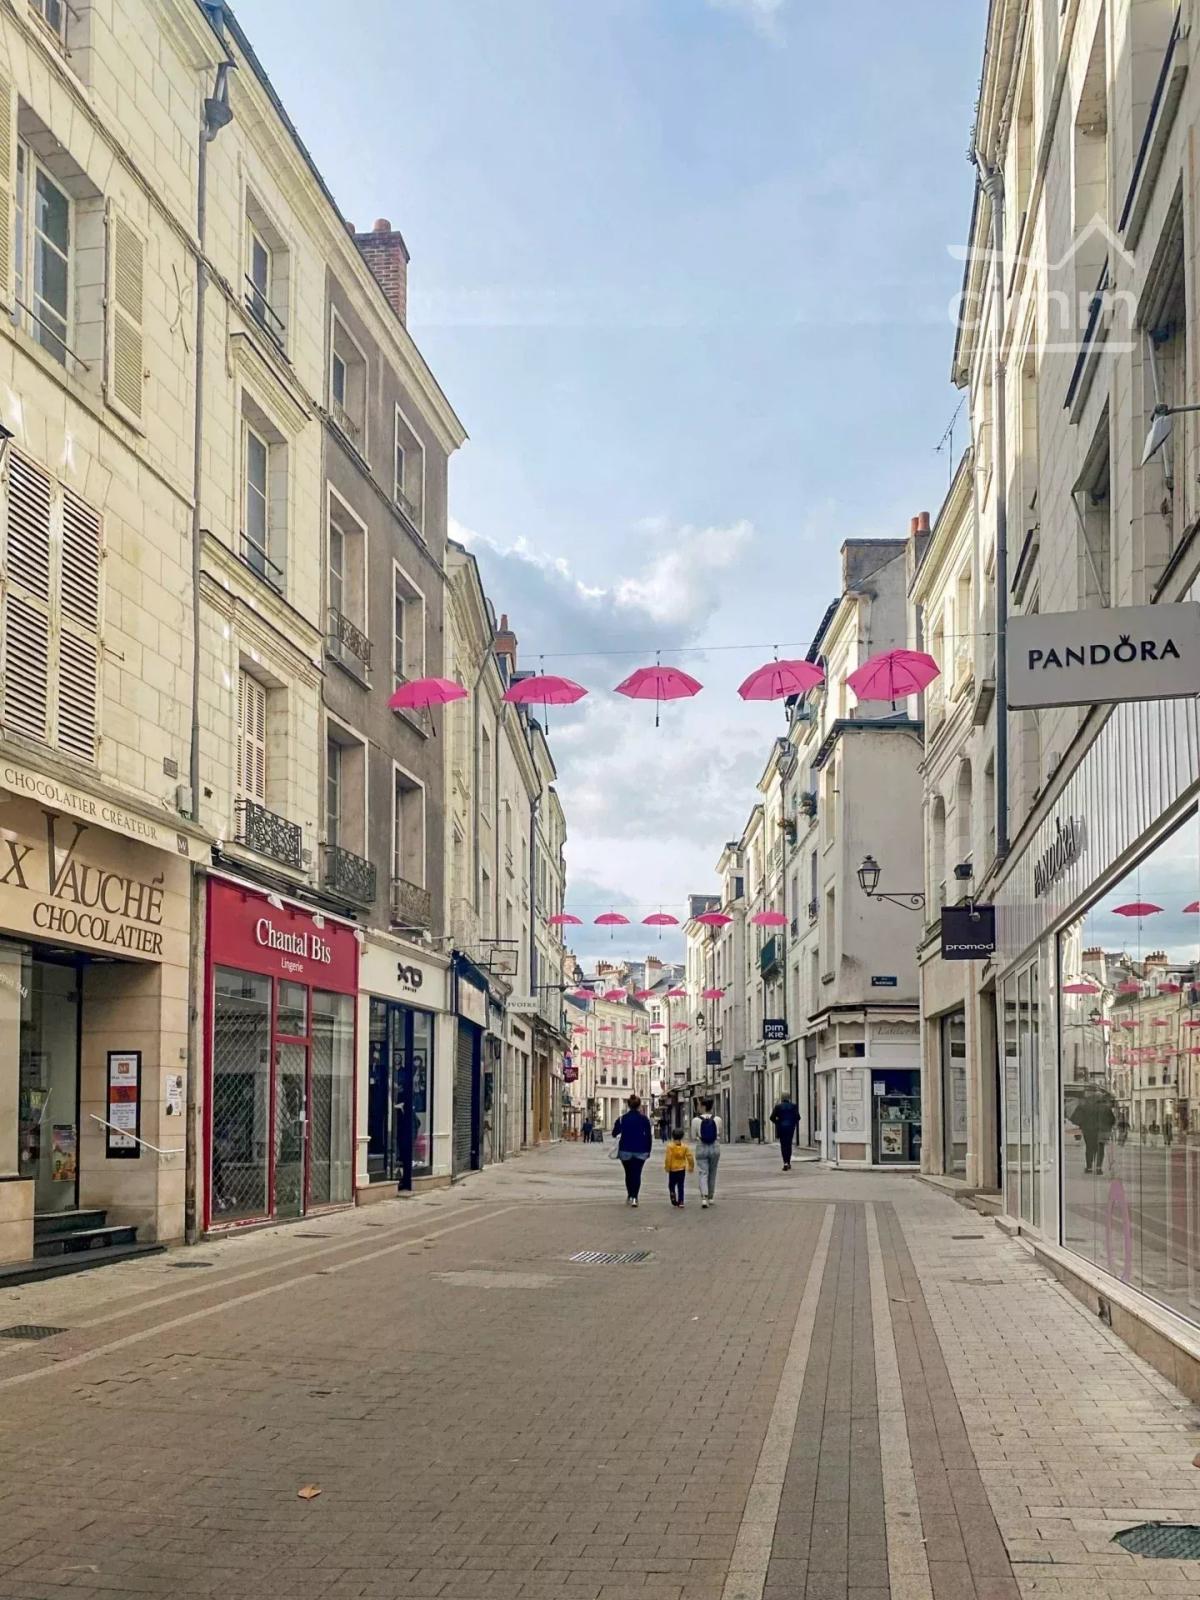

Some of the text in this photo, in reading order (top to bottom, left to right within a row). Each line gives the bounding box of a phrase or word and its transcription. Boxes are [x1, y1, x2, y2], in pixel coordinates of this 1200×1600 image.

[1028, 634, 1181, 670] PANDORA
[5, 768, 158, 841] CHOCOLATIER CRÉATEUR
[41, 810, 165, 926] VAUCHÉ
[32, 901, 164, 956] CHOCOLATIER
[256, 917, 332, 965] Chantal Bis
[945, 943, 994, 952] promod
[281, 957, 304, 973] Lingerie
